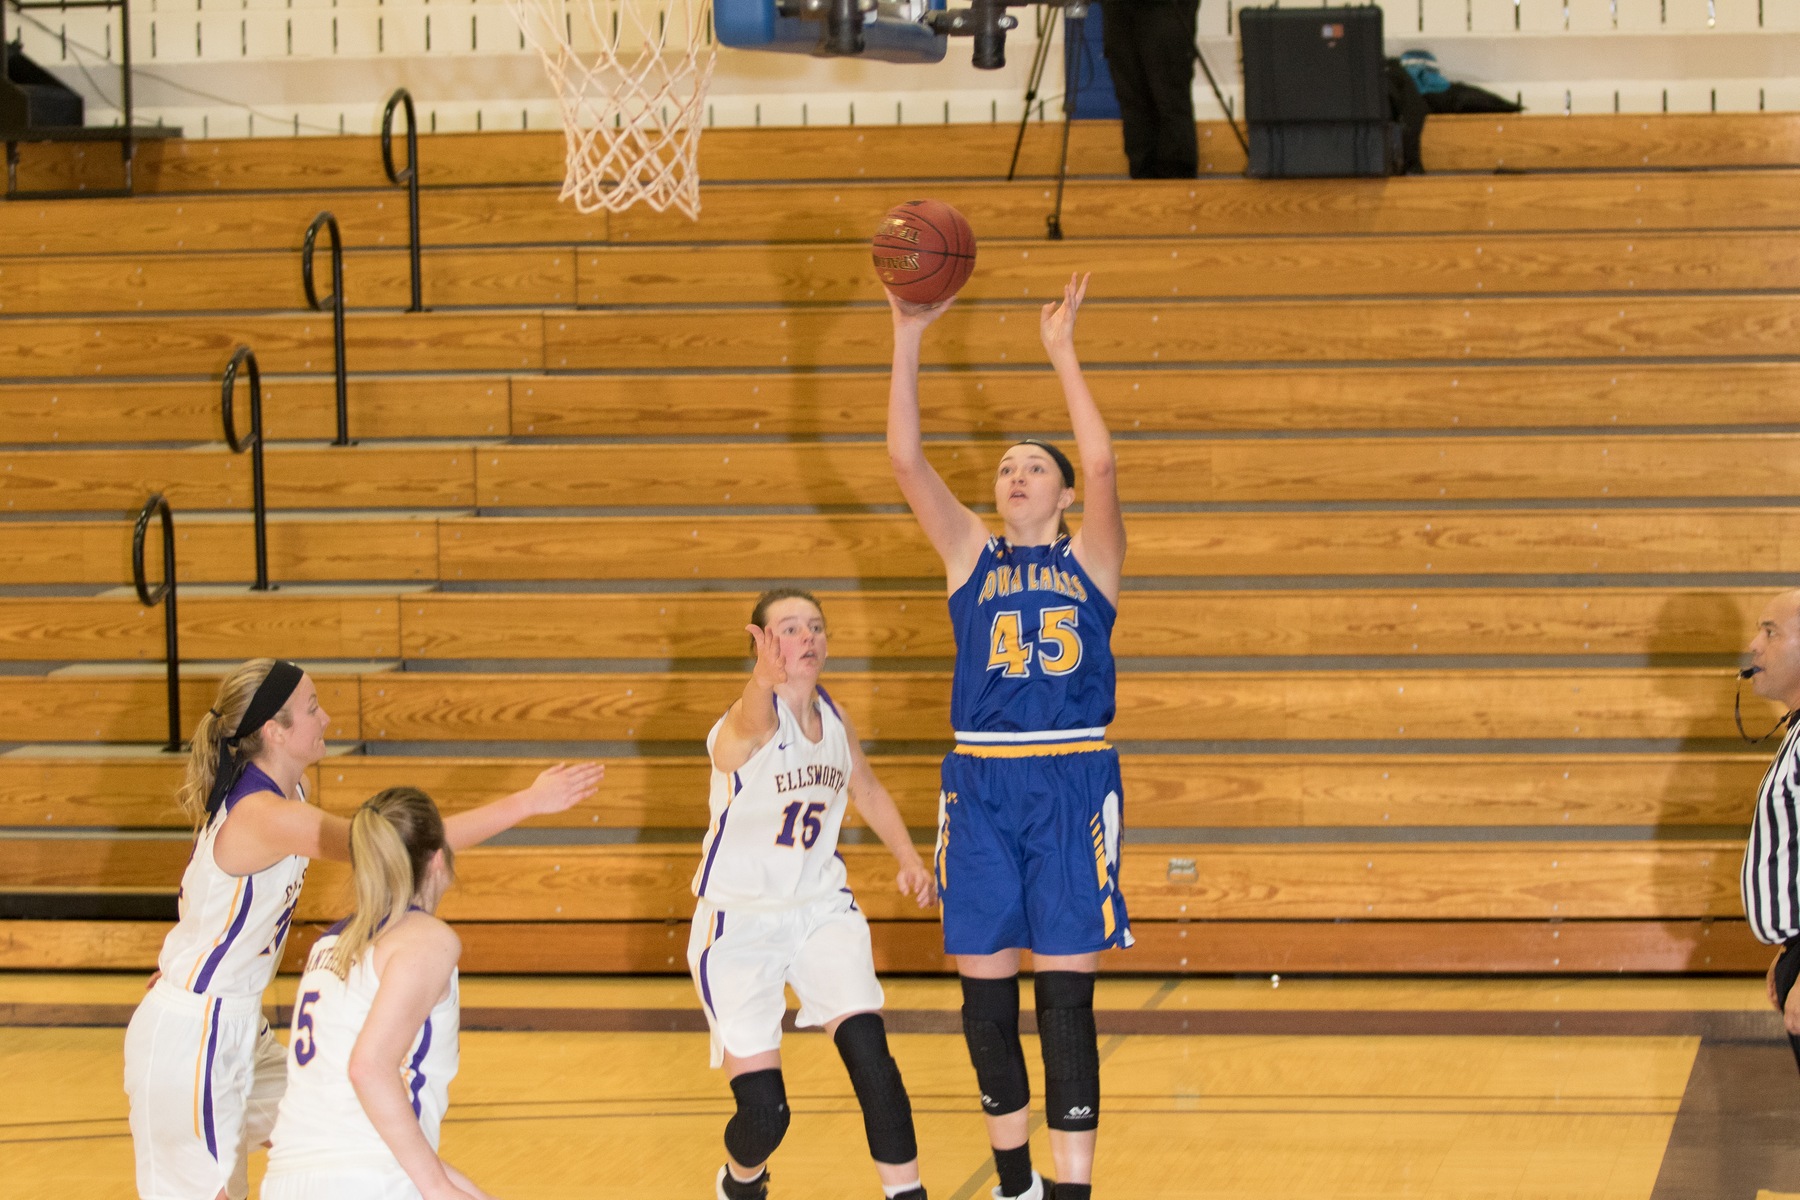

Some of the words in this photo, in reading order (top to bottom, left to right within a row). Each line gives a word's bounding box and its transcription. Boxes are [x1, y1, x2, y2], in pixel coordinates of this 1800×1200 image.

[986, 605, 1083, 678] 45
[774, 800, 827, 850] 15
[294, 990, 321, 1067] 5
